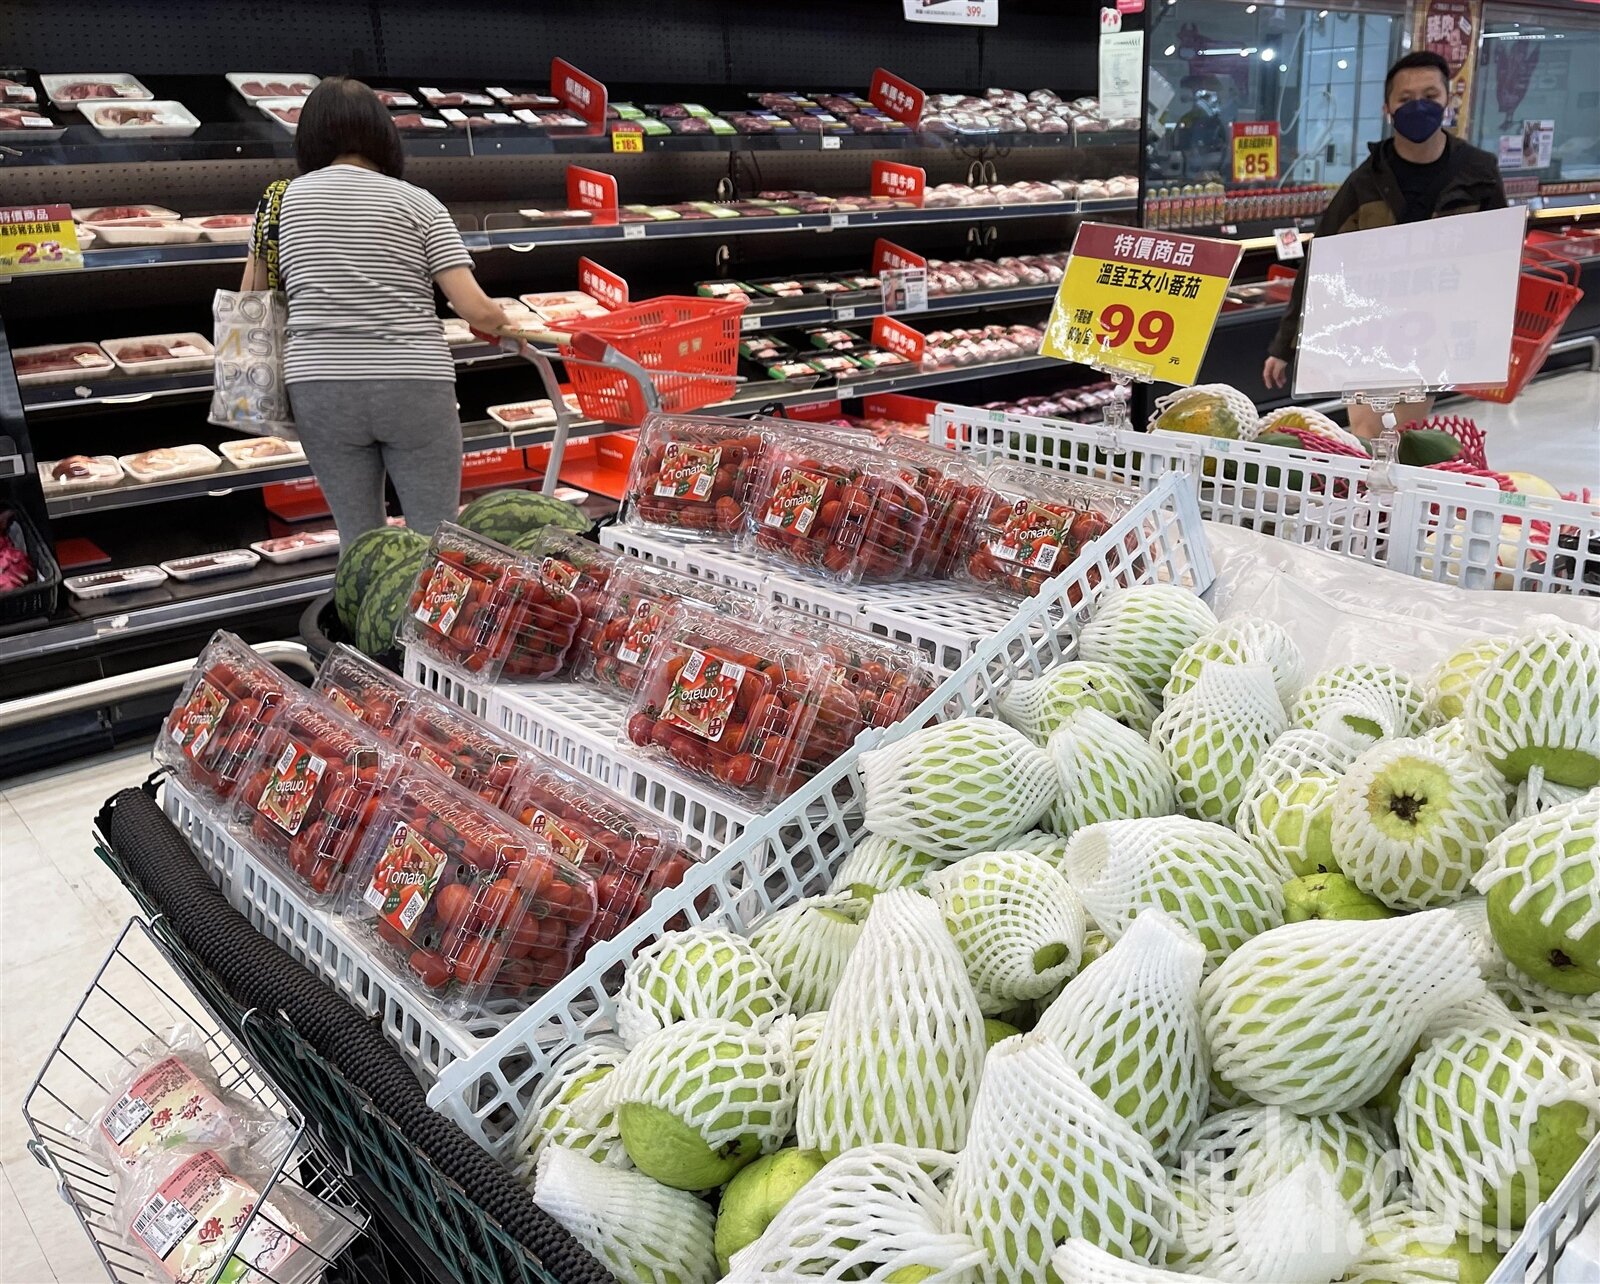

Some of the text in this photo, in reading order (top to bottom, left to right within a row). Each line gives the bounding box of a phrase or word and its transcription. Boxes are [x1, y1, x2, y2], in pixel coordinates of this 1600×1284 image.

[966, 6, 981, 17] 399
[880, 82, 915, 110] 美國牛肉
[1245, 153, 1270, 174] 85
[881, 172, 916, 190] 美國牛肉
[16, 241, 63, 264] 23
[1113, 233, 1196, 267] 特價商品
[1096, 263, 1203, 299] 溫室玉女小番茄
[1096, 303, 1175, 355] 99
[882, 325, 917, 353] 美國牛肉
[1168, 356, 1181, 365] 元
[668, 463, 707, 480] Tomato
[780, 494, 813, 509] Tomato
[1012, 527, 1056, 540] Tomato
[430, 591, 458, 604] Tomato
[681, 686, 726, 702] Tomato
[186, 711, 214, 725] Tomato
[275, 780, 309, 796] Tomato
[385, 865, 426, 885] Tomato
